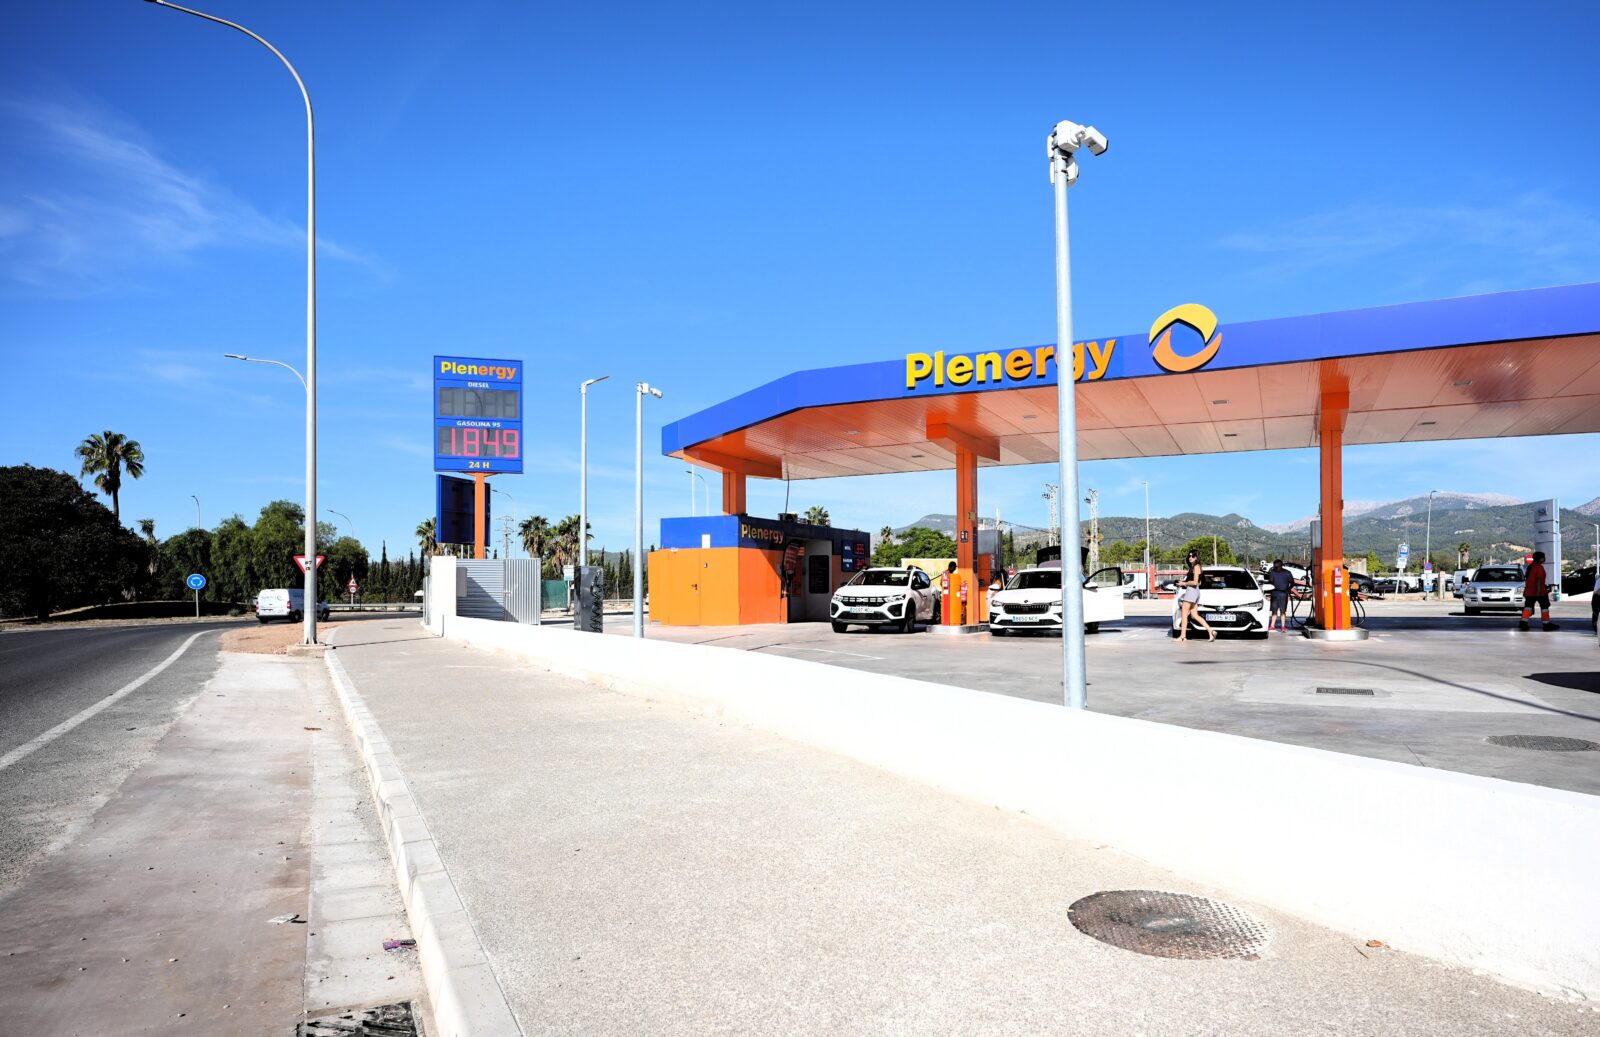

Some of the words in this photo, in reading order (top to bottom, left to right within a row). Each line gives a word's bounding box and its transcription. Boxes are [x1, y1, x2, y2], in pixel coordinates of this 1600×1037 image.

[441, 361, 516, 379] Plenergy
[456, 420, 491, 428] GASOLINA
[451, 428, 518, 457] 1.849
[468, 461, 480, 469] 24
[482, 461, 490, 469] H
[741, 523, 784, 544] Plenergy
